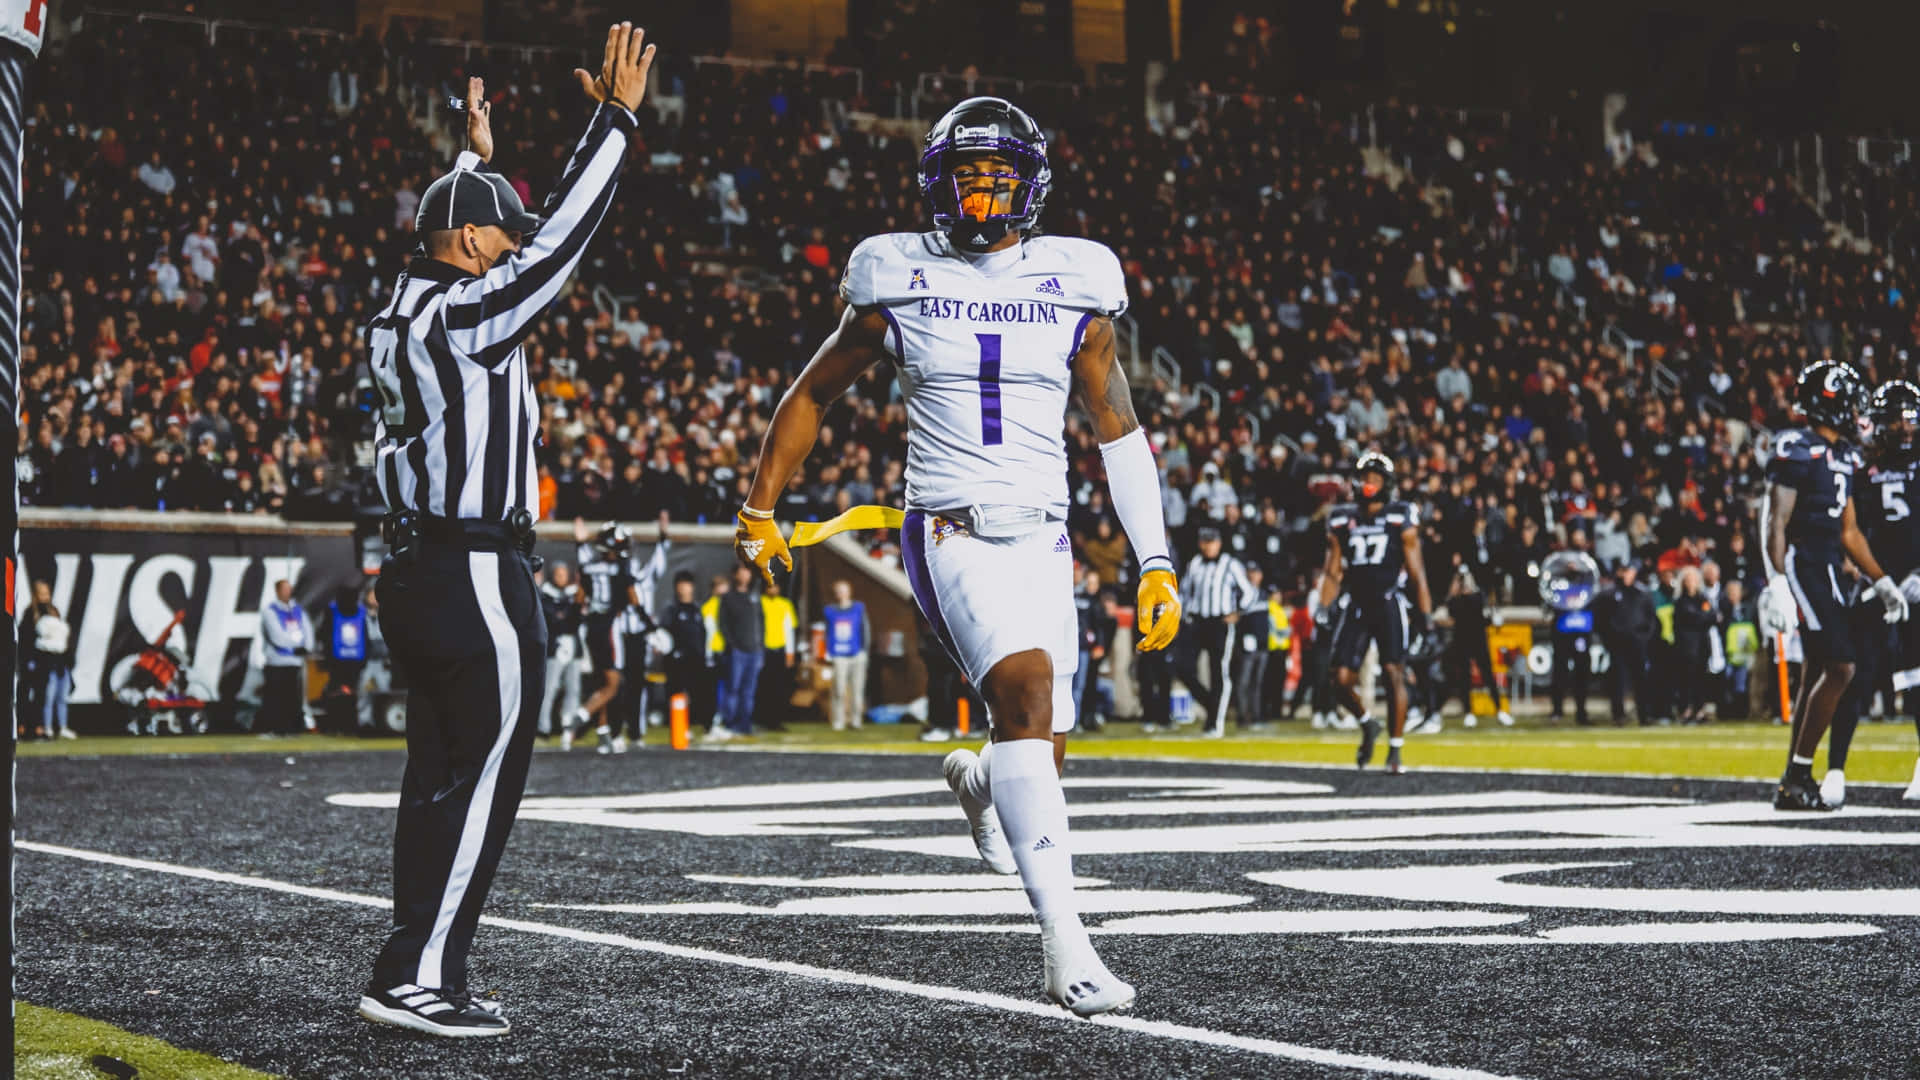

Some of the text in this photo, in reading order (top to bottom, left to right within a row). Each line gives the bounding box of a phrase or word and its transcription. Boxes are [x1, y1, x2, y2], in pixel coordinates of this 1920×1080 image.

[1036, 286, 1065, 297] adidas
[920, 297, 1058, 324] EAST CAROLINA
[974, 332, 1003, 446] 1
[1881, 481, 1910, 521] 5
